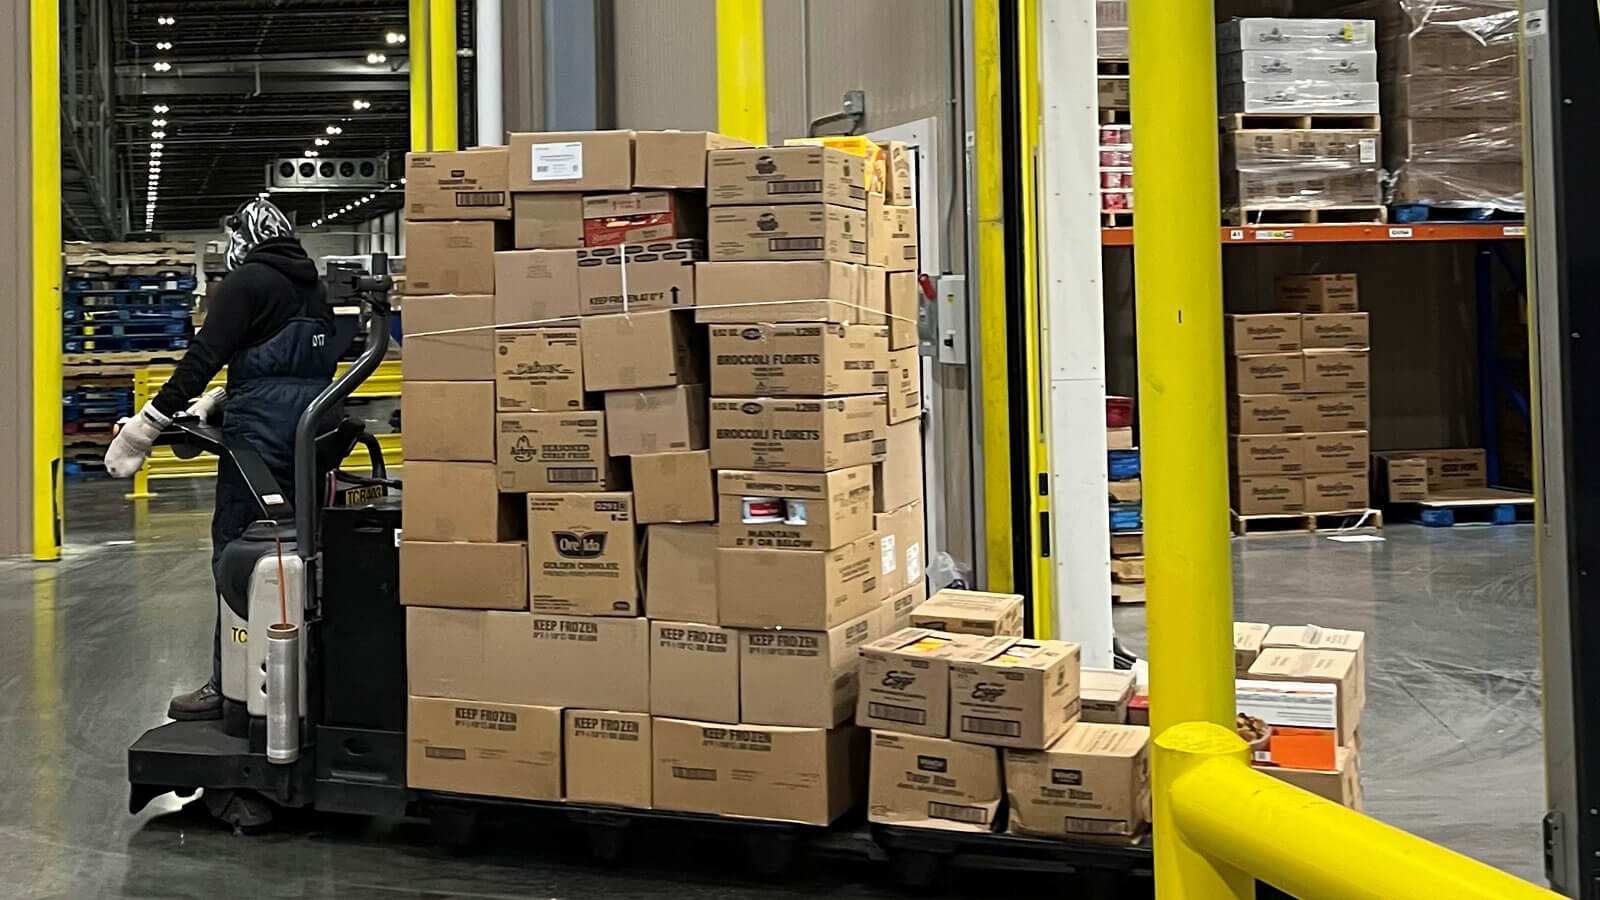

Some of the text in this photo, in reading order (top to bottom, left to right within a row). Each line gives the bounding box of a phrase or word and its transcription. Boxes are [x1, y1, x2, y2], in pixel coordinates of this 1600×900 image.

[717, 354, 821, 365] BROCCOLI FLORETS
[716, 429, 820, 440] BROCCOLI FLORETS
[748, 530, 800, 538] MAINTAIN
[776, 539, 813, 547] BELOW
[533, 619, 598, 634] KEEP FROZEN
[660, 628, 728, 644] KEEP FROZEN
[750, 634, 818, 648] KEEP FROZEN
[970, 682, 1006, 702] Eggo
[456, 707, 517, 723] KEEP FROZEN
[574, 718, 639, 733] KEEP FROZEN
[703, 728, 772, 743] KEEP FROZEN
